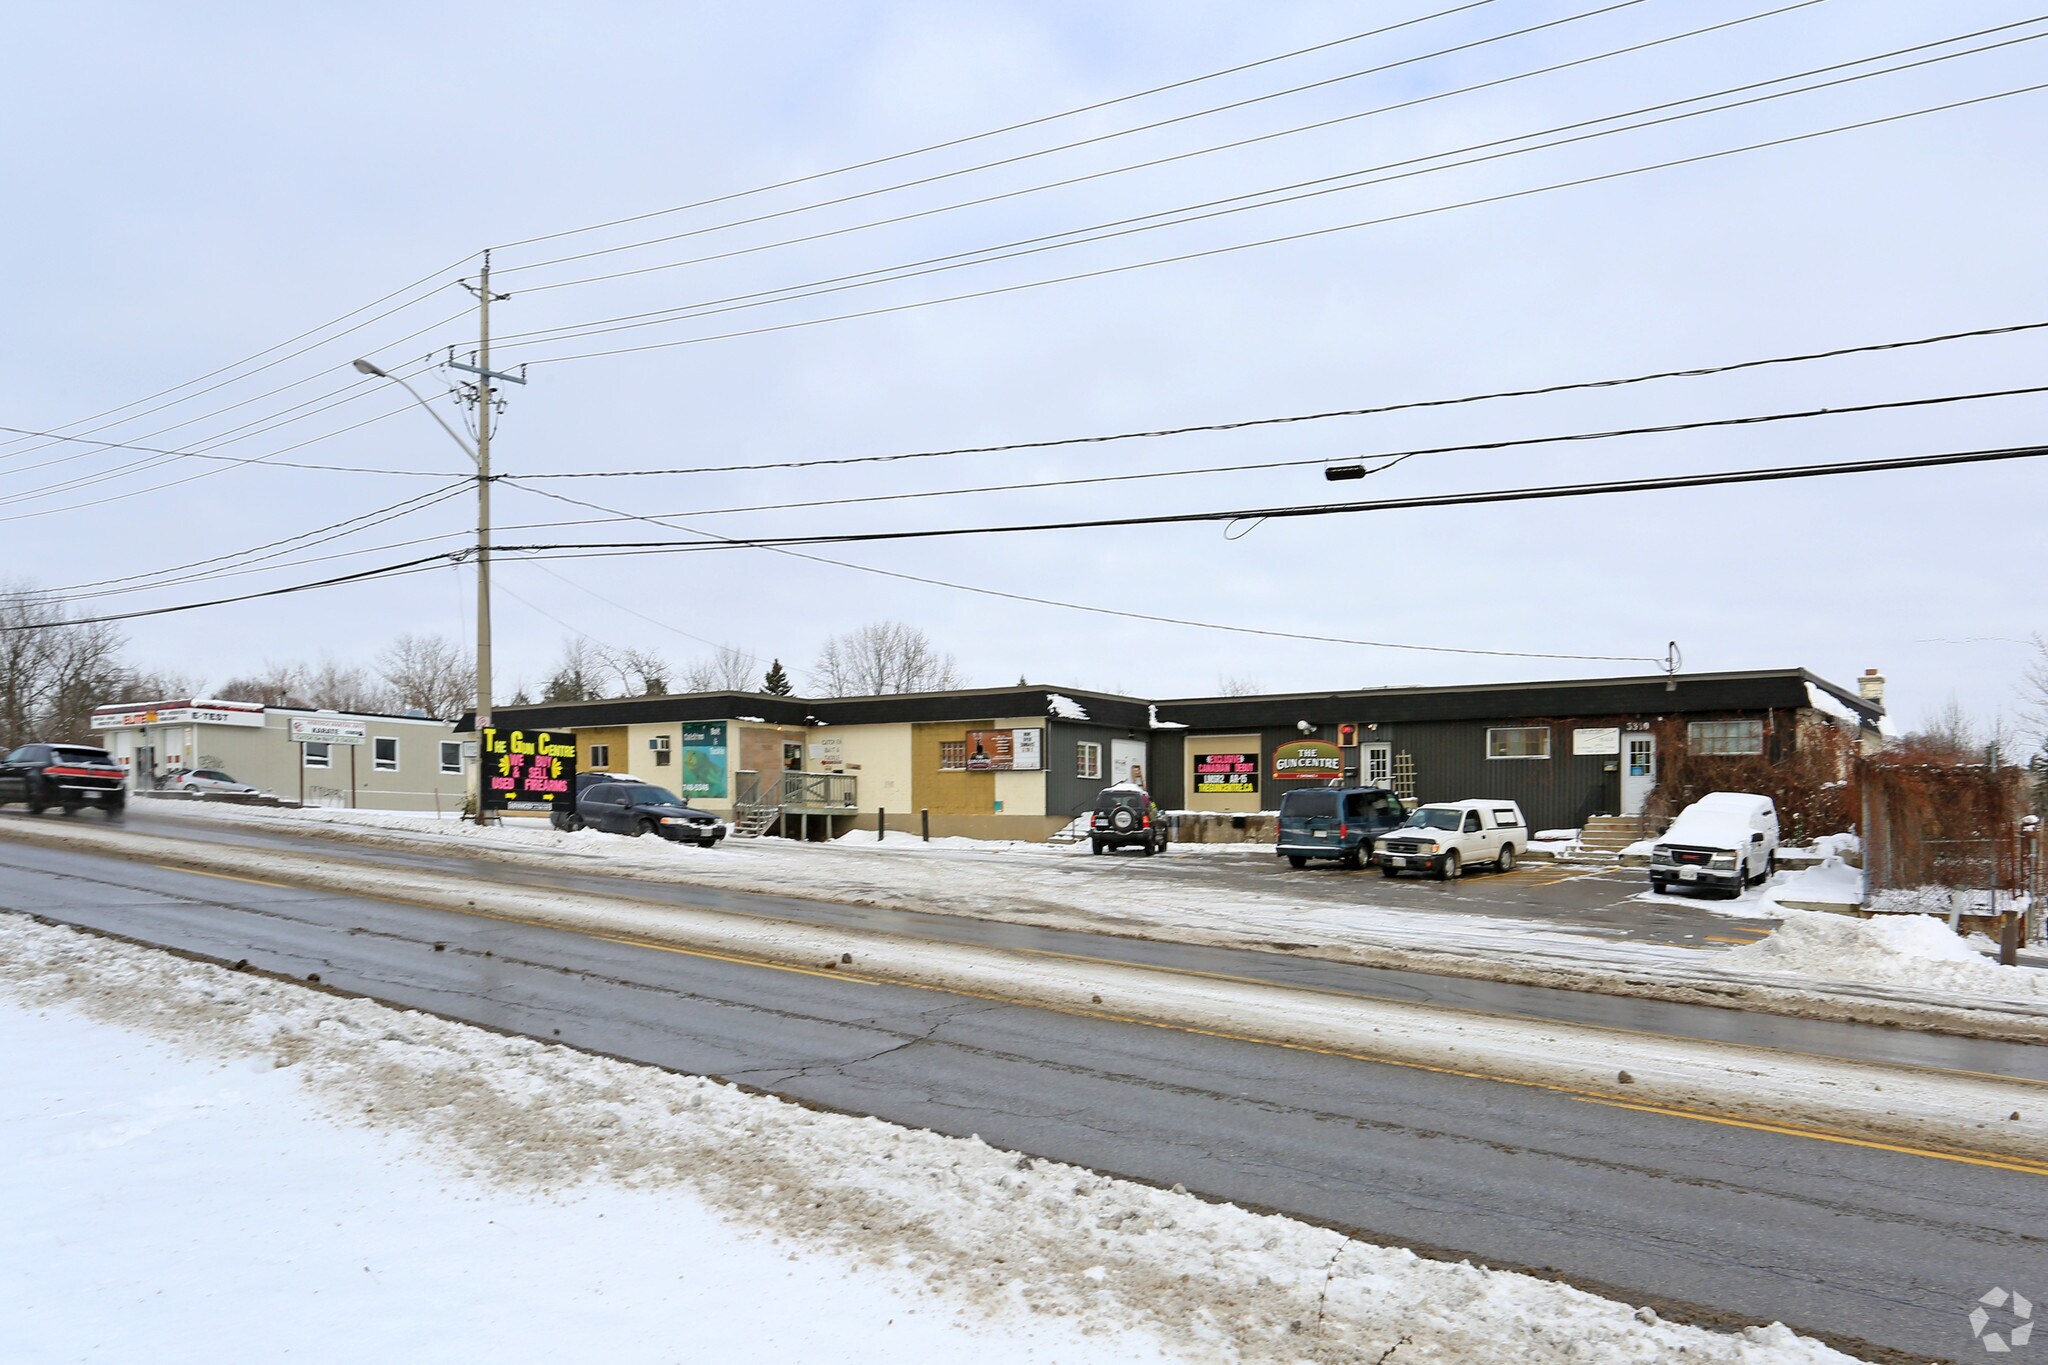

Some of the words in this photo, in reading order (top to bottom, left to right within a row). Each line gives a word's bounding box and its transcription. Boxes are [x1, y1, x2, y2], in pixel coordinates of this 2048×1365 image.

[192, 712, 229, 722] E-TEST
[312, 727, 340, 735] KARATE
[1298, 749, 1318, 757] THE
[509, 754, 524, 766] WE
[534, 755, 553, 768] BUY
[1276, 759, 1297, 770] GUN
[1298, 758, 1340, 769] CENTRE
[512, 766, 520, 778] &
[528, 767, 548, 779] SELL
[1198, 763, 1231, 772] CANADIAN
[491, 776, 515, 789] USED
[524, 778, 568, 792] FIREARMS
